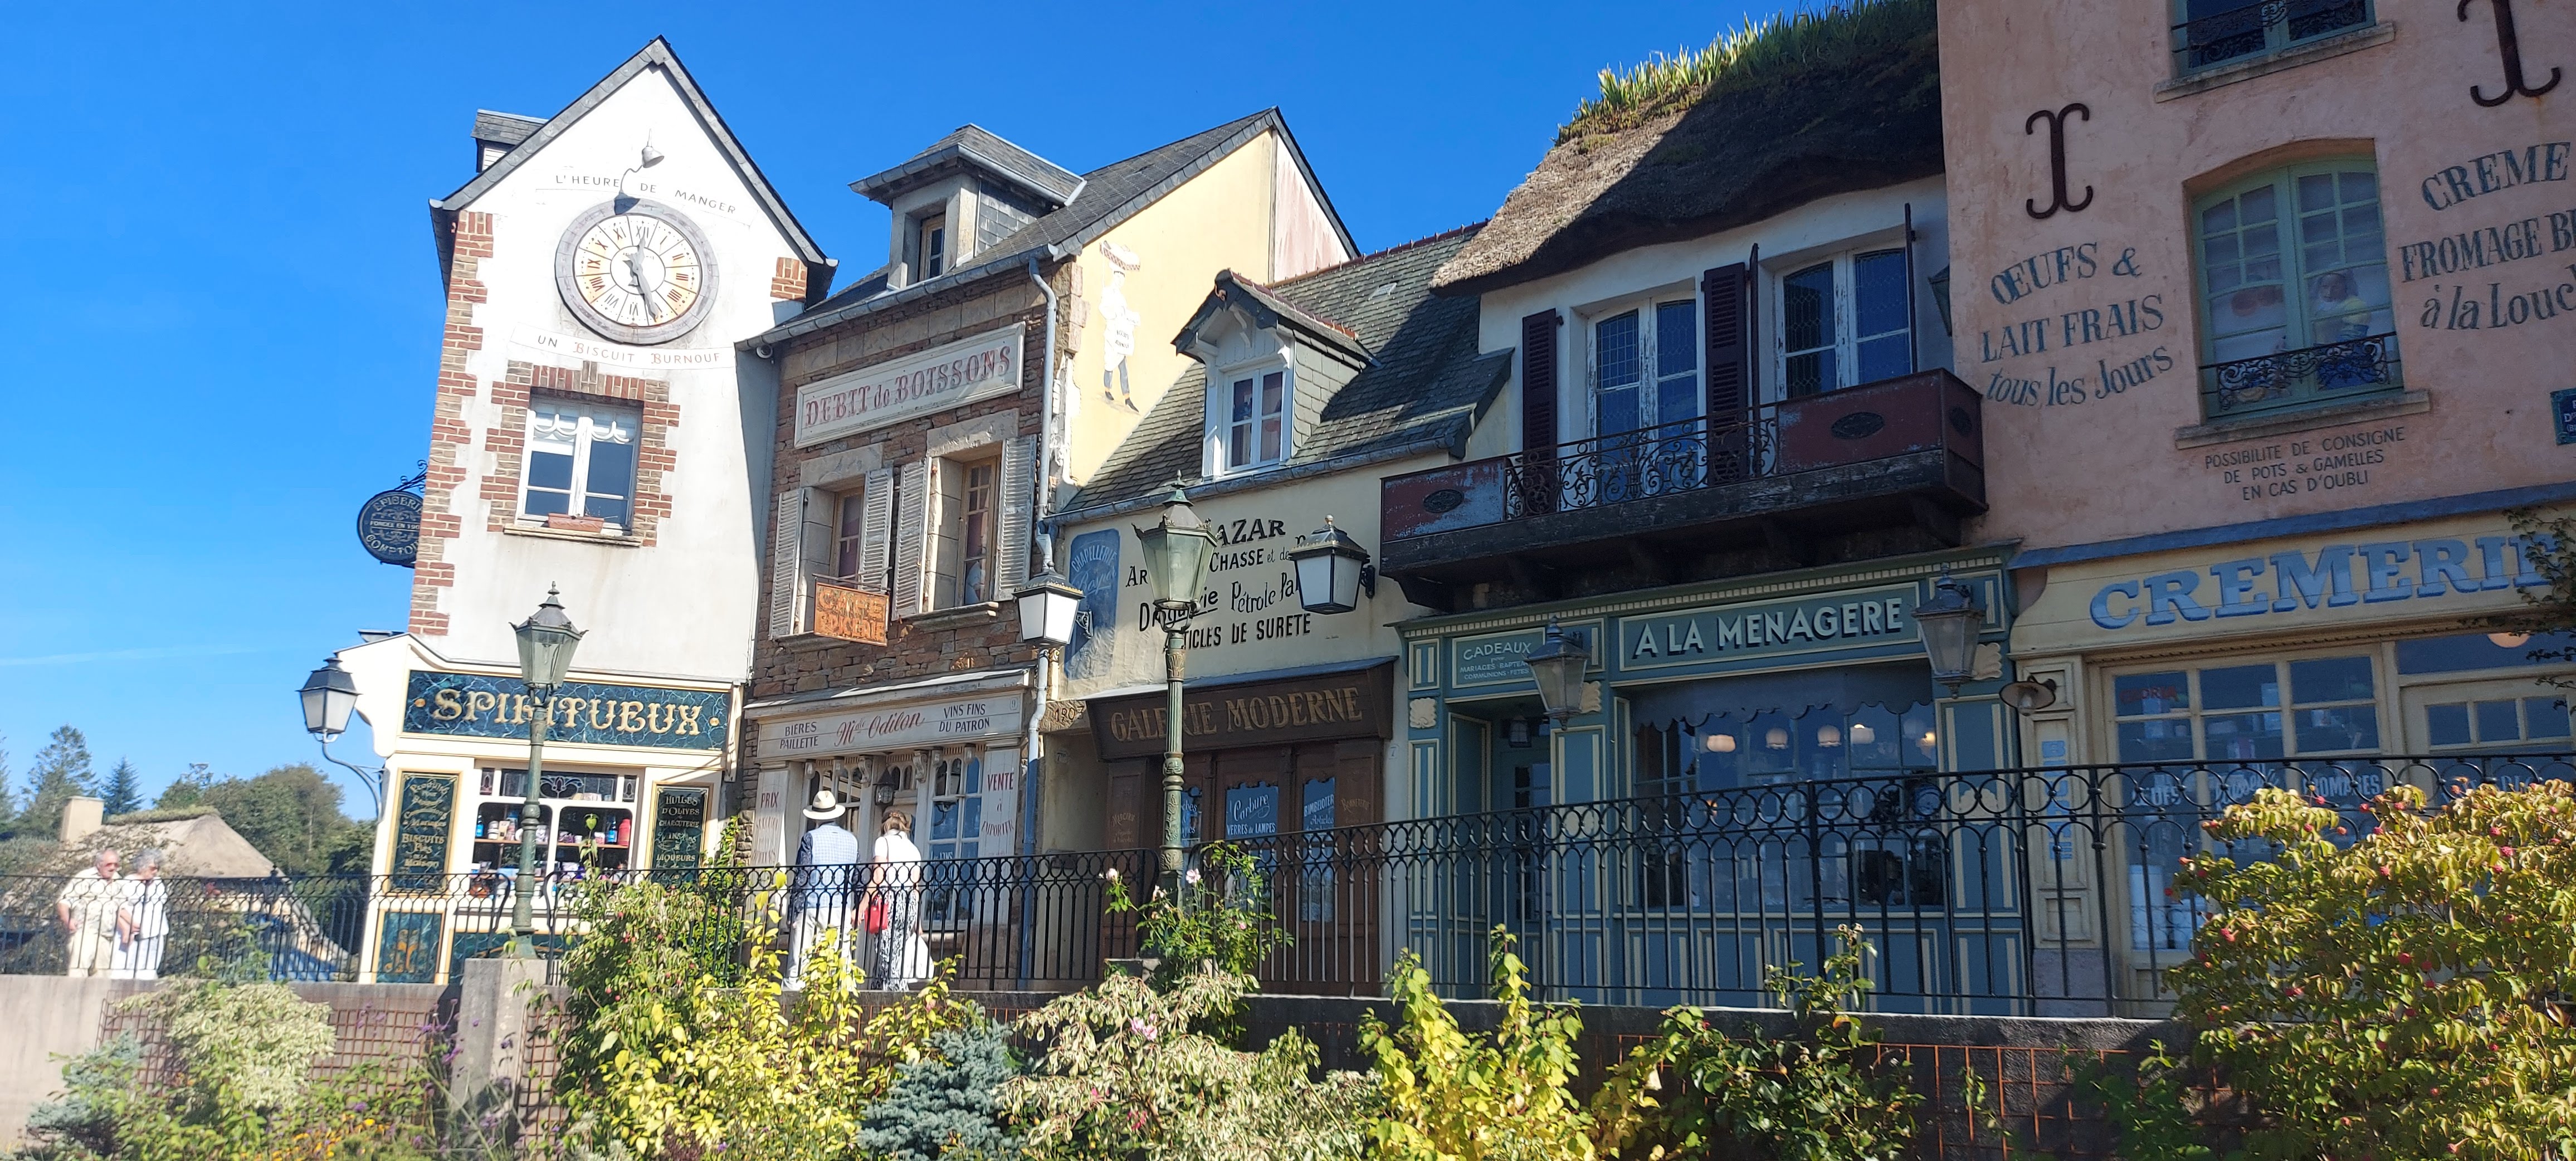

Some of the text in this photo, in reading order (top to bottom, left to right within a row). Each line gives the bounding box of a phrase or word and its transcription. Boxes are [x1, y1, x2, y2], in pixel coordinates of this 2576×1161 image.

[2421, 142, 2571, 211] CREME
[555, 175, 736, 214] L'HEURE DE MANGER
[2398, 217, 2542, 283] FROMAGE
[1990, 242, 2142, 305] ŒUFS &
[2420, 284, 2441, 329] à
[2446, 285, 2480, 330] la
[1982, 294, 2164, 363] LAIT FRAIS
[537, 335, 720, 365] UN BISCUIT BURNOUF
[805, 346, 1011, 428] DEBIT de BOISSONS
[1987, 368, 2041, 406] tous
[2047, 367, 2086, 406] les
[2205, 426, 2406, 469] POSSIBILITE DE CONSIGNE
[2224, 449, 2384, 484] DE POTS & GAMELLES
[2242, 470, 2368, 500] EN CAS D'OUBLI
[1216, 518, 1286, 547] AZAR
[1071, 544, 1118, 573] CHAPELLERIE
[1209, 548, 1265, 573] CHASSE
[1267, 549, 1276, 563] et
[1231, 580, 1276, 614] Pétrole
[1231, 622, 1247, 645] DE
[1256, 613, 1311, 641] SURETE
[1635, 597, 1904, 657] A LA MENAGERE
[1463, 642, 1531, 660] CADEAUX
[1460, 664, 1496, 674] MARIAGES
[1464, 670, 1506, 680] COMMUNIONS
[868, 711, 925, 738] Odilon
[943, 704, 964, 719] VINS
[967, 703, 986, 715] FINS
[1226, 686, 1363, 733] MODERNE
[780, 717, 990, 750] PAILLETTE DU PATRON
[987, 772, 1014, 792] VENTE
[665, 796, 699, 806] HUILES
[761, 792, 779, 808] PRIX
[1233, 794, 1270, 822] Carbure
[402, 833, 445, 845] BISCUITS
[981, 818, 1014, 837] EMPORTER
[1227, 824, 1248, 836] VERRES
[1255, 822, 1276, 833] LAMPES
[656, 854, 696, 863] LIQUEURS
